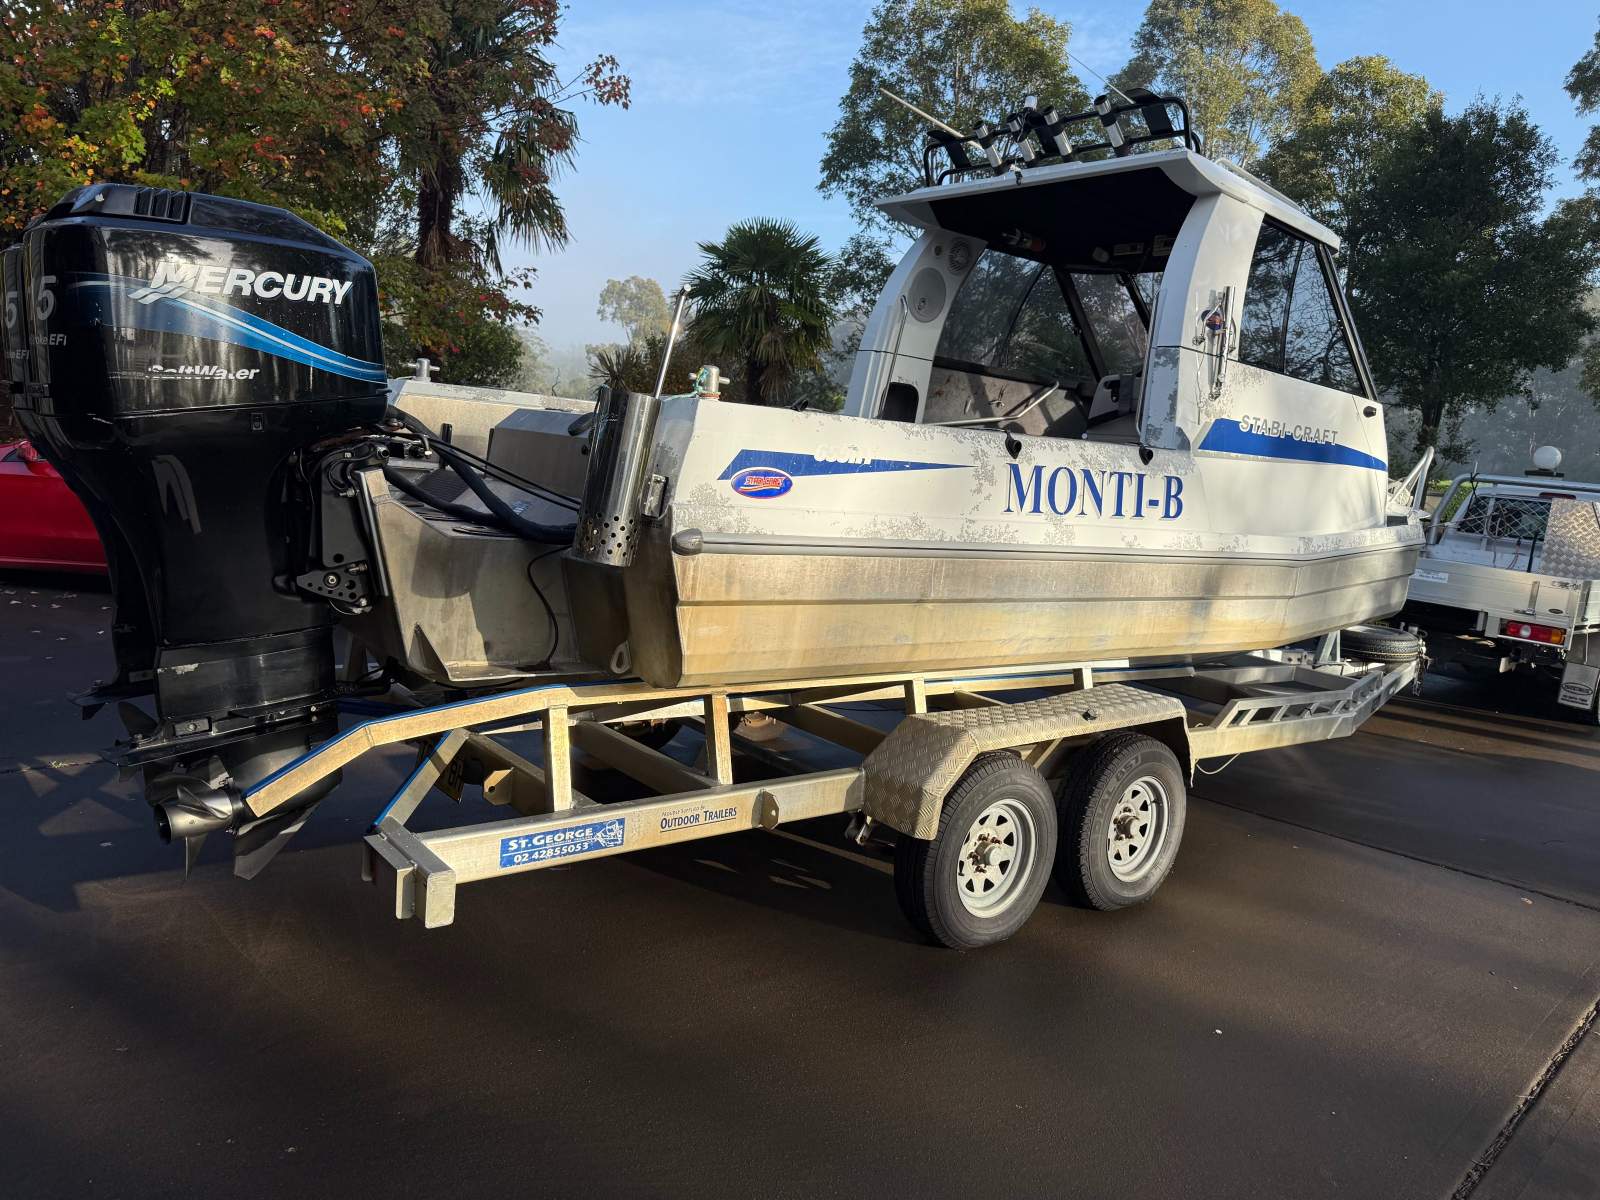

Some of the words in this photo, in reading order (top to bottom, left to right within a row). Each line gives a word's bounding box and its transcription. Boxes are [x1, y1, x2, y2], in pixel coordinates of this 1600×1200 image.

[129, 262, 353, 304] MERCURY
[1240, 414, 1339, 446] STABI-CRAFT
[1004, 463, 1185, 521] MONTI-B
[660, 814, 700, 829] OUTDOOR
[703, 807, 737, 821] TRAILERS
[513, 854, 529, 863] 02
[531, 843, 589, 860] 42855053
